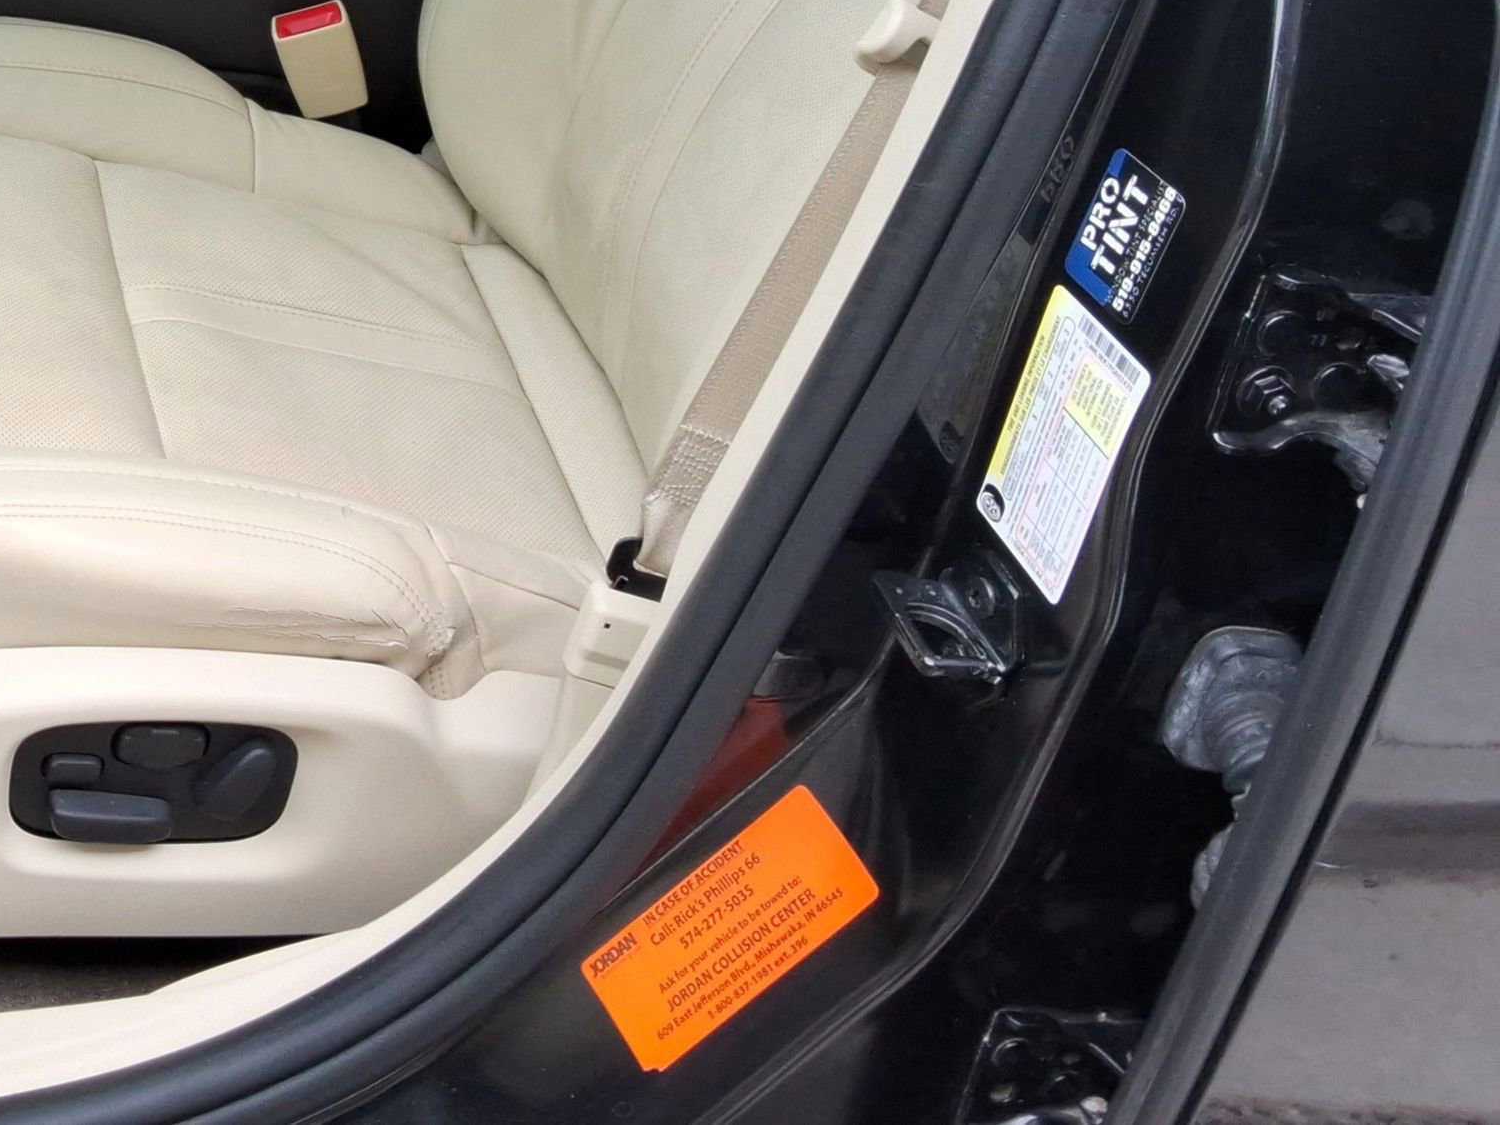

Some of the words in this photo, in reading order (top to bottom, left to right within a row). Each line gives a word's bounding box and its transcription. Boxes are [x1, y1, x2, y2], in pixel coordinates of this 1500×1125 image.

[1080, 177, 1120, 251] PRO
[1091, 174, 1148, 275] TINT
[1112, 185, 1176, 312] 519-915-8468
[1125, 232, 1142, 257] TINT
[641, 911, 656, 927] IN
[653, 890, 682, 917] CASE
[678, 879, 695, 896] OF
[692, 839, 744, 885] ACCIDENT
[648, 919, 676, 947] Call:
[672, 895, 706, 928] Rick's
[702, 862, 748, 906] Phillips
[742, 851, 761, 870] 66
[678, 882, 755, 950] 574-277-5035
[587, 931, 637, 978] JORDAN
[655, 1021, 675, 1041] 609
[672, 1006, 693, 1027] East
[690, 976, 732, 1013] Jefferson
[752, 916, 806, 963] Mishawaka,
[802, 908, 817, 923] IN
[813, 886, 844, 914] 46545
[656, 974, 676, 994] Ask
[673, 963, 689, 980] for
[687, 950, 711, 972] your
[706, 923, 739, 954] vehicle
[737, 916, 749, 929] to
[747, 906, 761, 921] be
[758, 883, 789, 912] towed
[786, 873, 803, 890] to:
[664, 968, 714, 1013] JORDAN
[710, 922, 772, 976] COLLISION
[768, 886, 816, 929] CENTER
[706, 962, 774, 1020] 1-800-837-1981
[772, 948, 792, 968] ext.
[789, 934, 809, 954] 396
